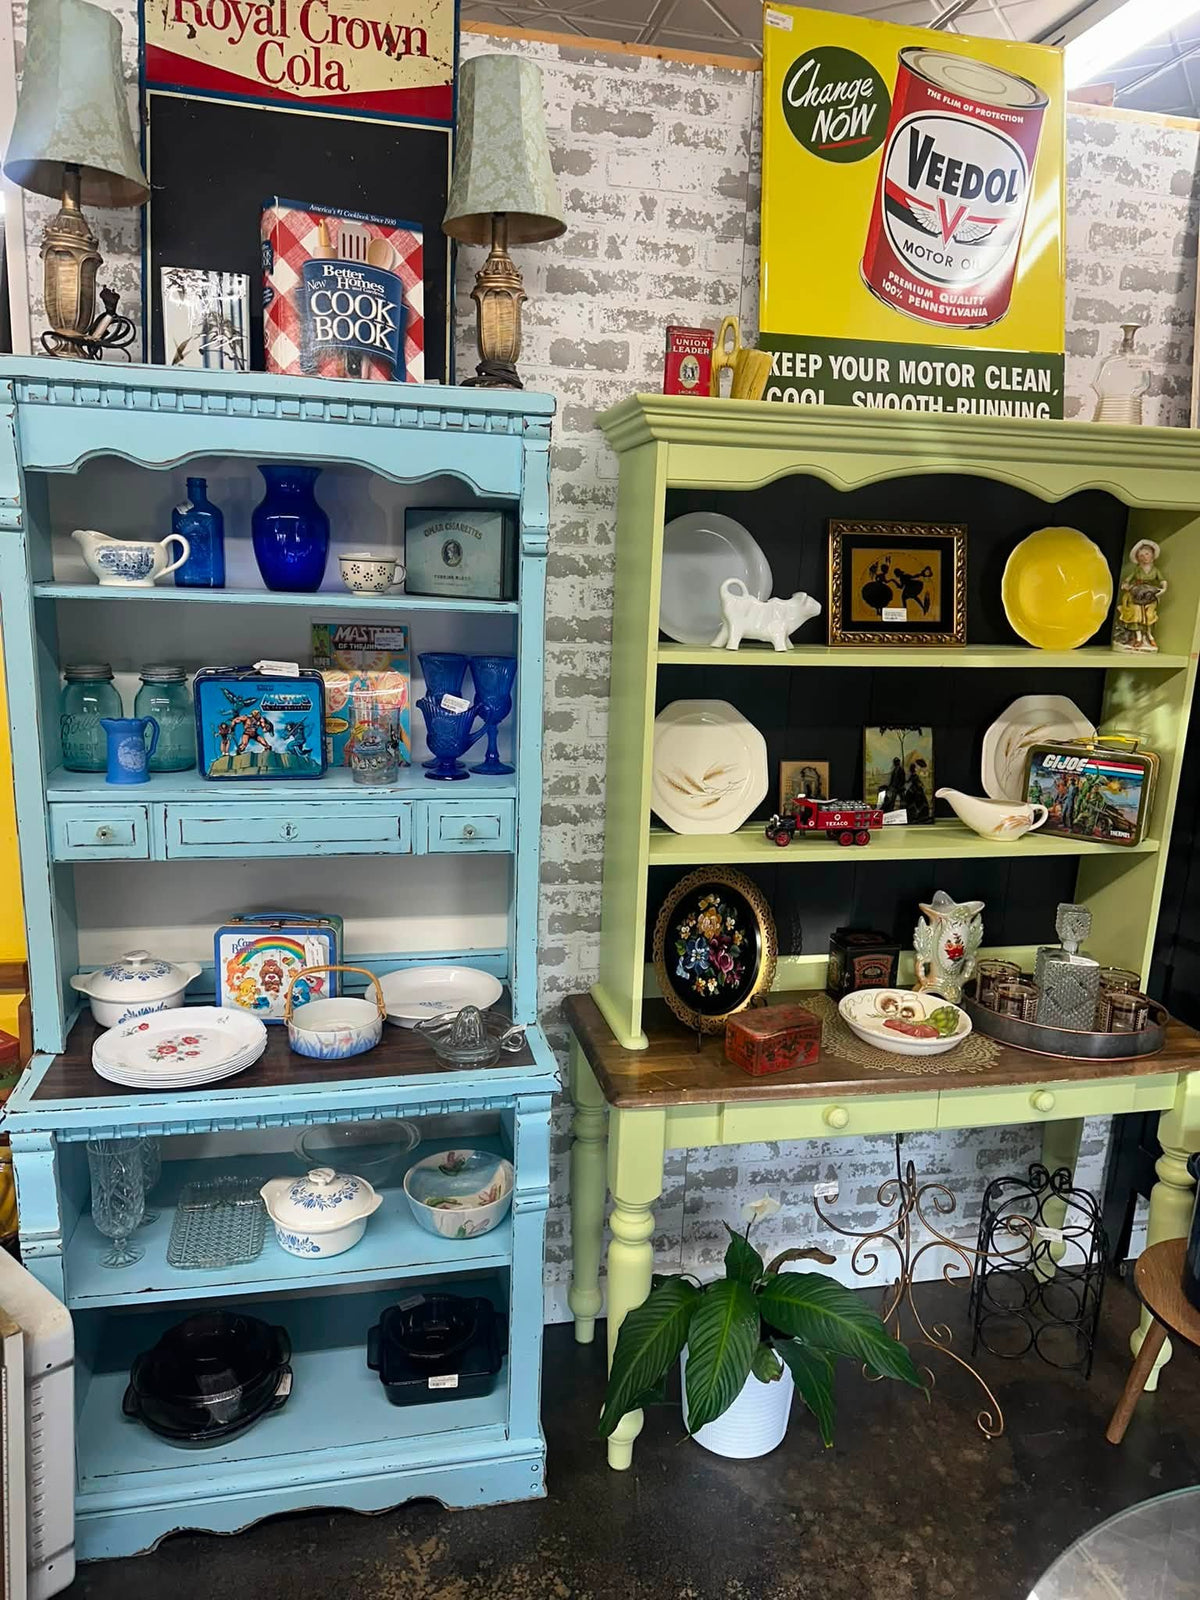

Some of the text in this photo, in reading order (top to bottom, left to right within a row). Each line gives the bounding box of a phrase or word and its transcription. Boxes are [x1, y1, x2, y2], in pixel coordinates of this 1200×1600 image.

[300, 0, 430, 57] Crown
[256, 40, 350, 92] Cola
[787, 59, 873, 109] Change
[811, 103, 877, 143] NOW
[927, 88, 941, 100] THE
[963, 104, 974, 112] OF
[975, 107, 1024, 123] PROTECTION
[907, 126, 1020, 204] VEEDOL
[309, 204, 336, 215] America's
[343, 210, 369, 221] Cookbook
[370, 215, 384, 223] Since
[903, 239, 953, 267] MOTOR
[307, 279, 327, 292] New
[322, 264, 365, 280] Better
[336, 276, 385, 293] Homes
[888, 271, 985, 305] PREMIUM QUALITY
[310, 290, 397, 329] COOK
[882, 279, 988, 316] 100% PENNSYLVANIA
[312, 316, 396, 352] BOOK
[672, 345, 710, 355] LEADER
[676, 338, 708, 347] UNION
[767, 352, 1059, 396] KEEP YOUR MOTOR CLEAN,
